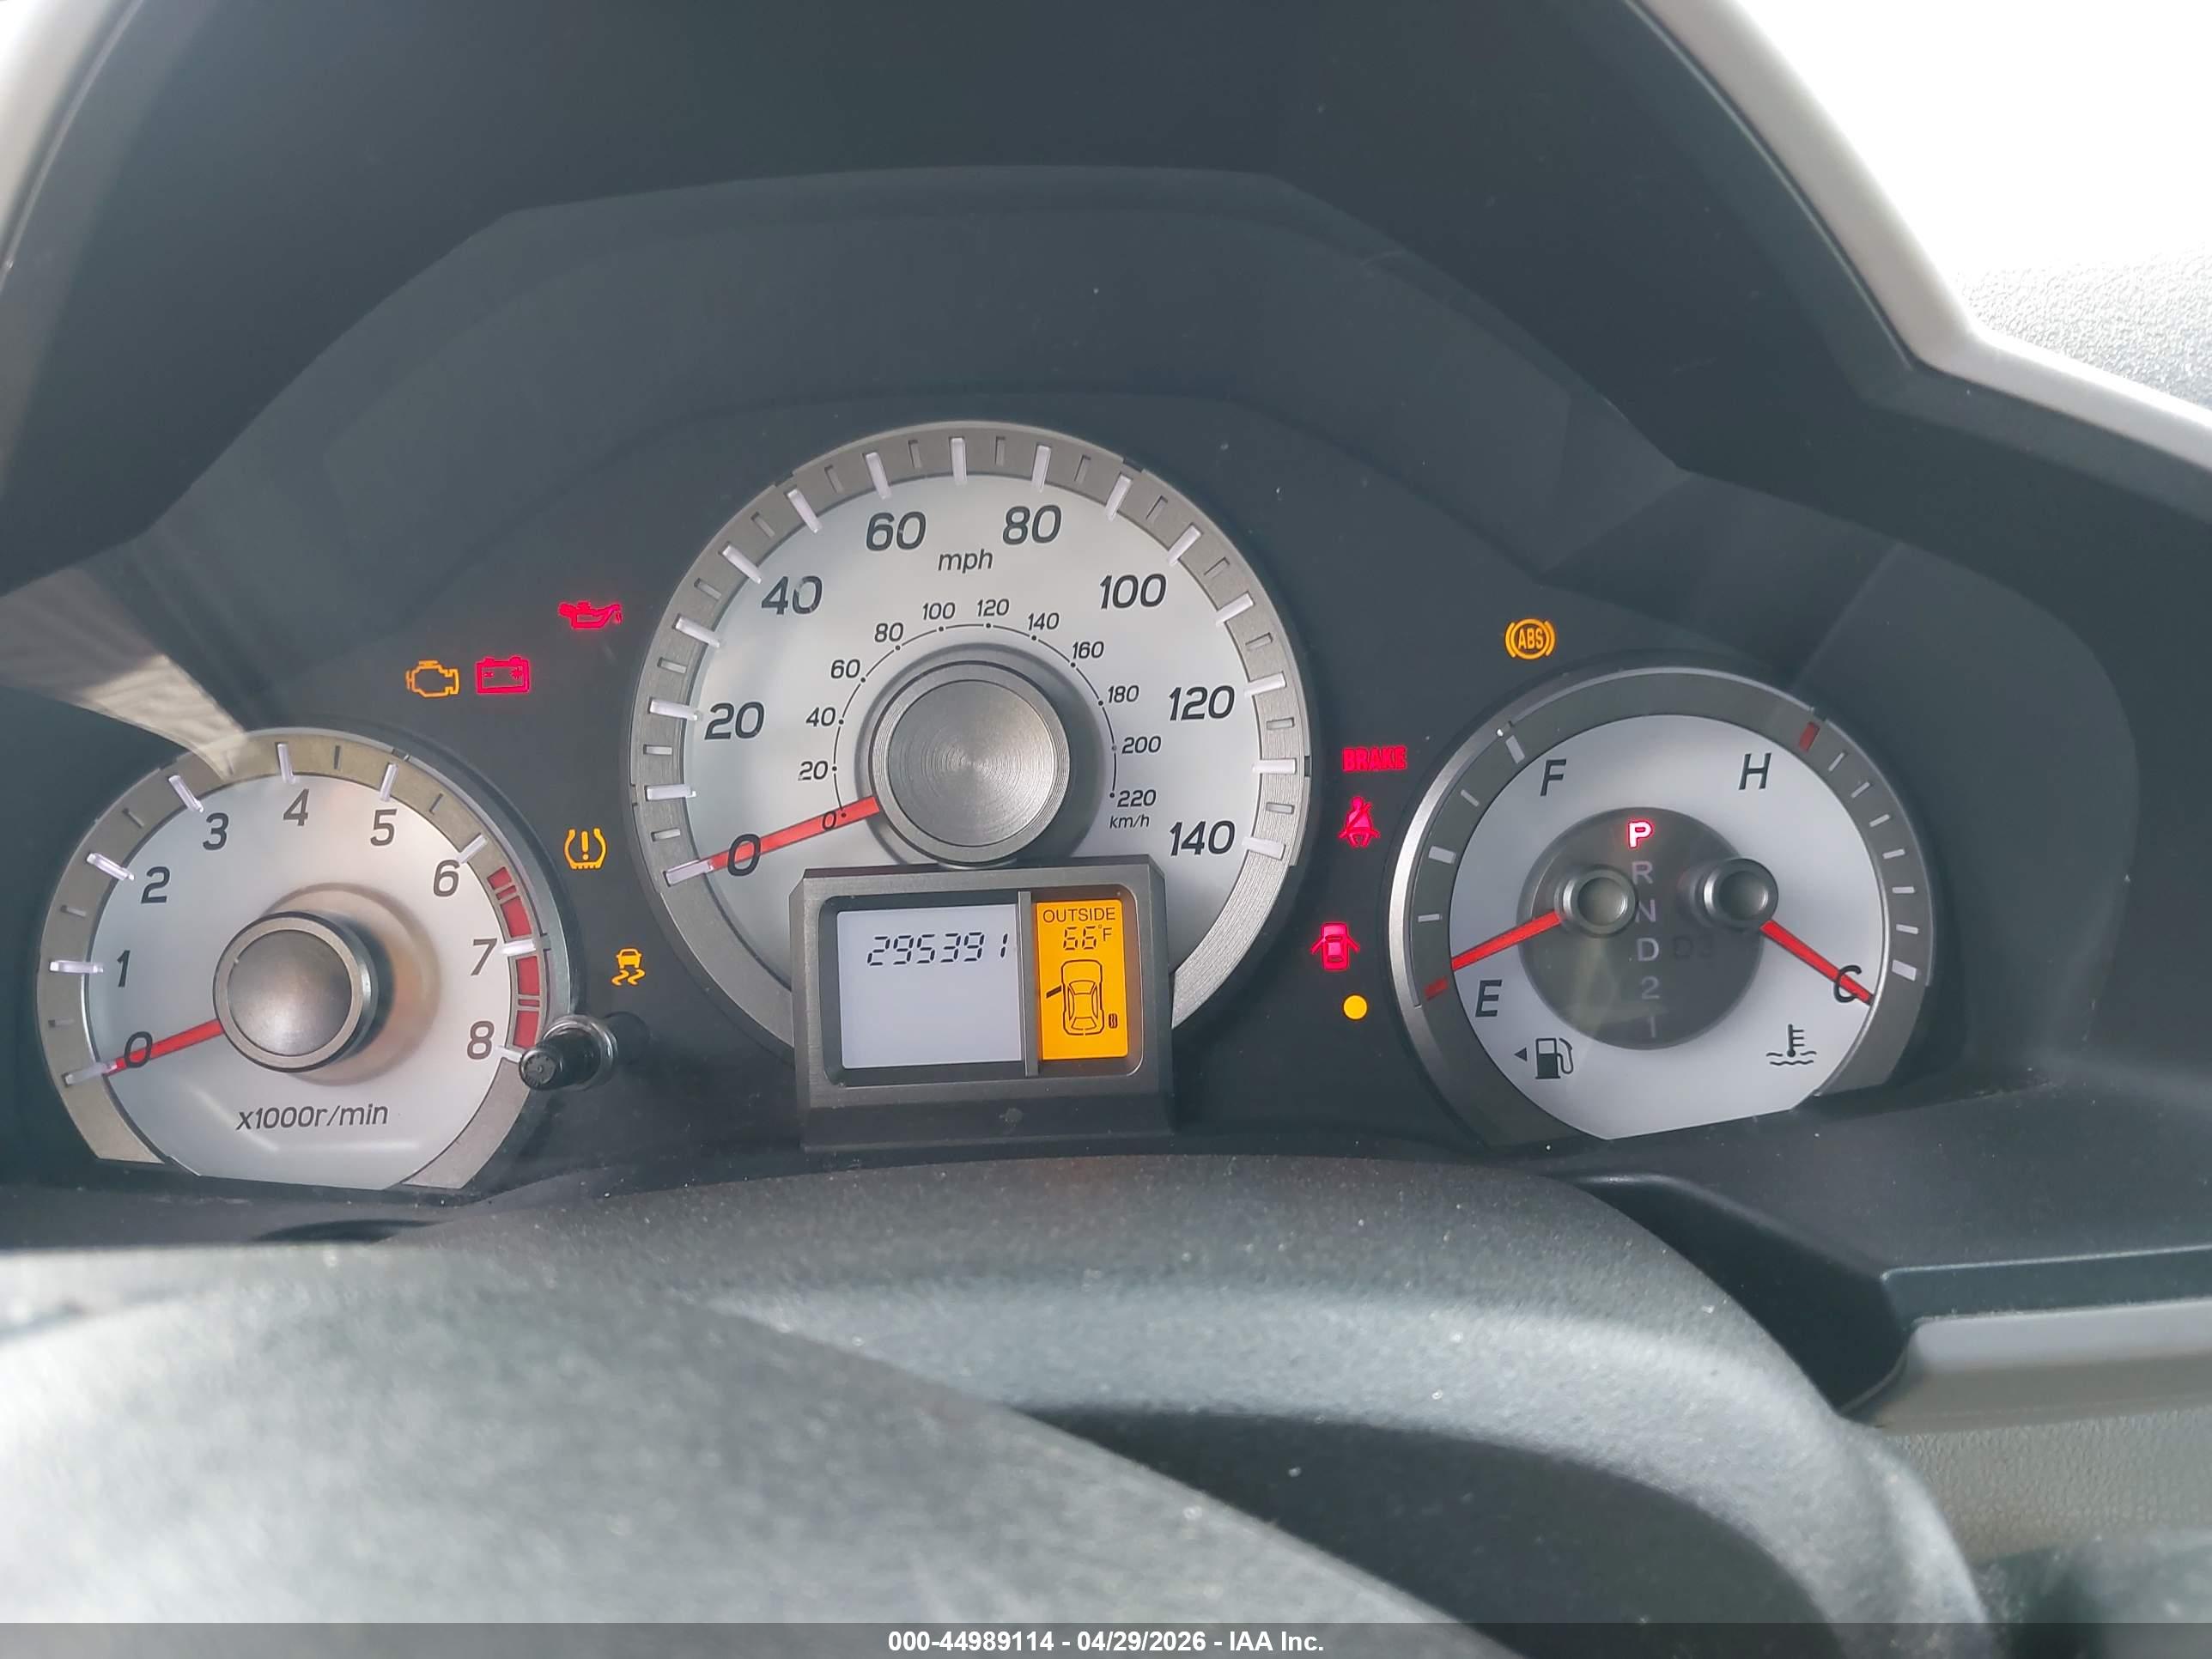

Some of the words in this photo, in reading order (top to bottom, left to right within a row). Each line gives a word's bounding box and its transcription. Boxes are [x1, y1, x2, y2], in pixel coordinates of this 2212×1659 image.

[865, 510, 927, 550] 60
[1002, 504, 1062, 544] 80
[938, 550, 994, 574] mph
[761, 575, 823, 615] 40
[1099, 573, 1167, 610] 100
[921, 601, 956, 621] 100
[975, 599, 1010, 618] 120
[1027, 611, 1060, 632] 140
[873, 623, 904, 643] 80
[1517, 627, 1545, 650] ABS
[1072, 641, 1105, 660] 160
[830, 659, 861, 680] 60
[1107, 684, 1139, 704] 180
[1169, 685, 1236, 721] 120
[704, 701, 765, 740] 20
[805, 707, 836, 727] 40
[1121, 736, 1162, 755] 200
[1342, 745, 1407, 772] BRAKE
[799, 761, 830, 781] 20
[1540, 758, 1567, 796] F
[1738, 752, 1772, 790] H
[283, 787, 310, 827] 4
[1116, 789, 1157, 808] 220
[203, 811, 230, 851] 3
[370, 808, 398, 846] 5
[822, 812, 839, 831] 0
[1109, 813, 1150, 831] km/h
[1169, 819, 1236, 856] 140
[1628, 820, 1654, 848] P
[726, 832, 763, 877] 0
[141, 865, 171, 904] 2
[432, 858, 460, 897] 6
[1632, 860, 1654, 885] R
[1042, 907, 1115, 923] OUTSIDE
[1635, 899, 1656, 923] N
[470, 938, 498, 976] 7
[866, 931, 1009, 967] 295391
[1637, 937, 1660, 962] D
[116, 949, 131, 988] 1
[1833, 964, 1863, 1005] C
[1475, 979, 1503, 1018] E
[1641, 975, 1661, 1000] 2
[124, 1031, 154, 1069] 0
[466, 1020, 494, 1059] 8
